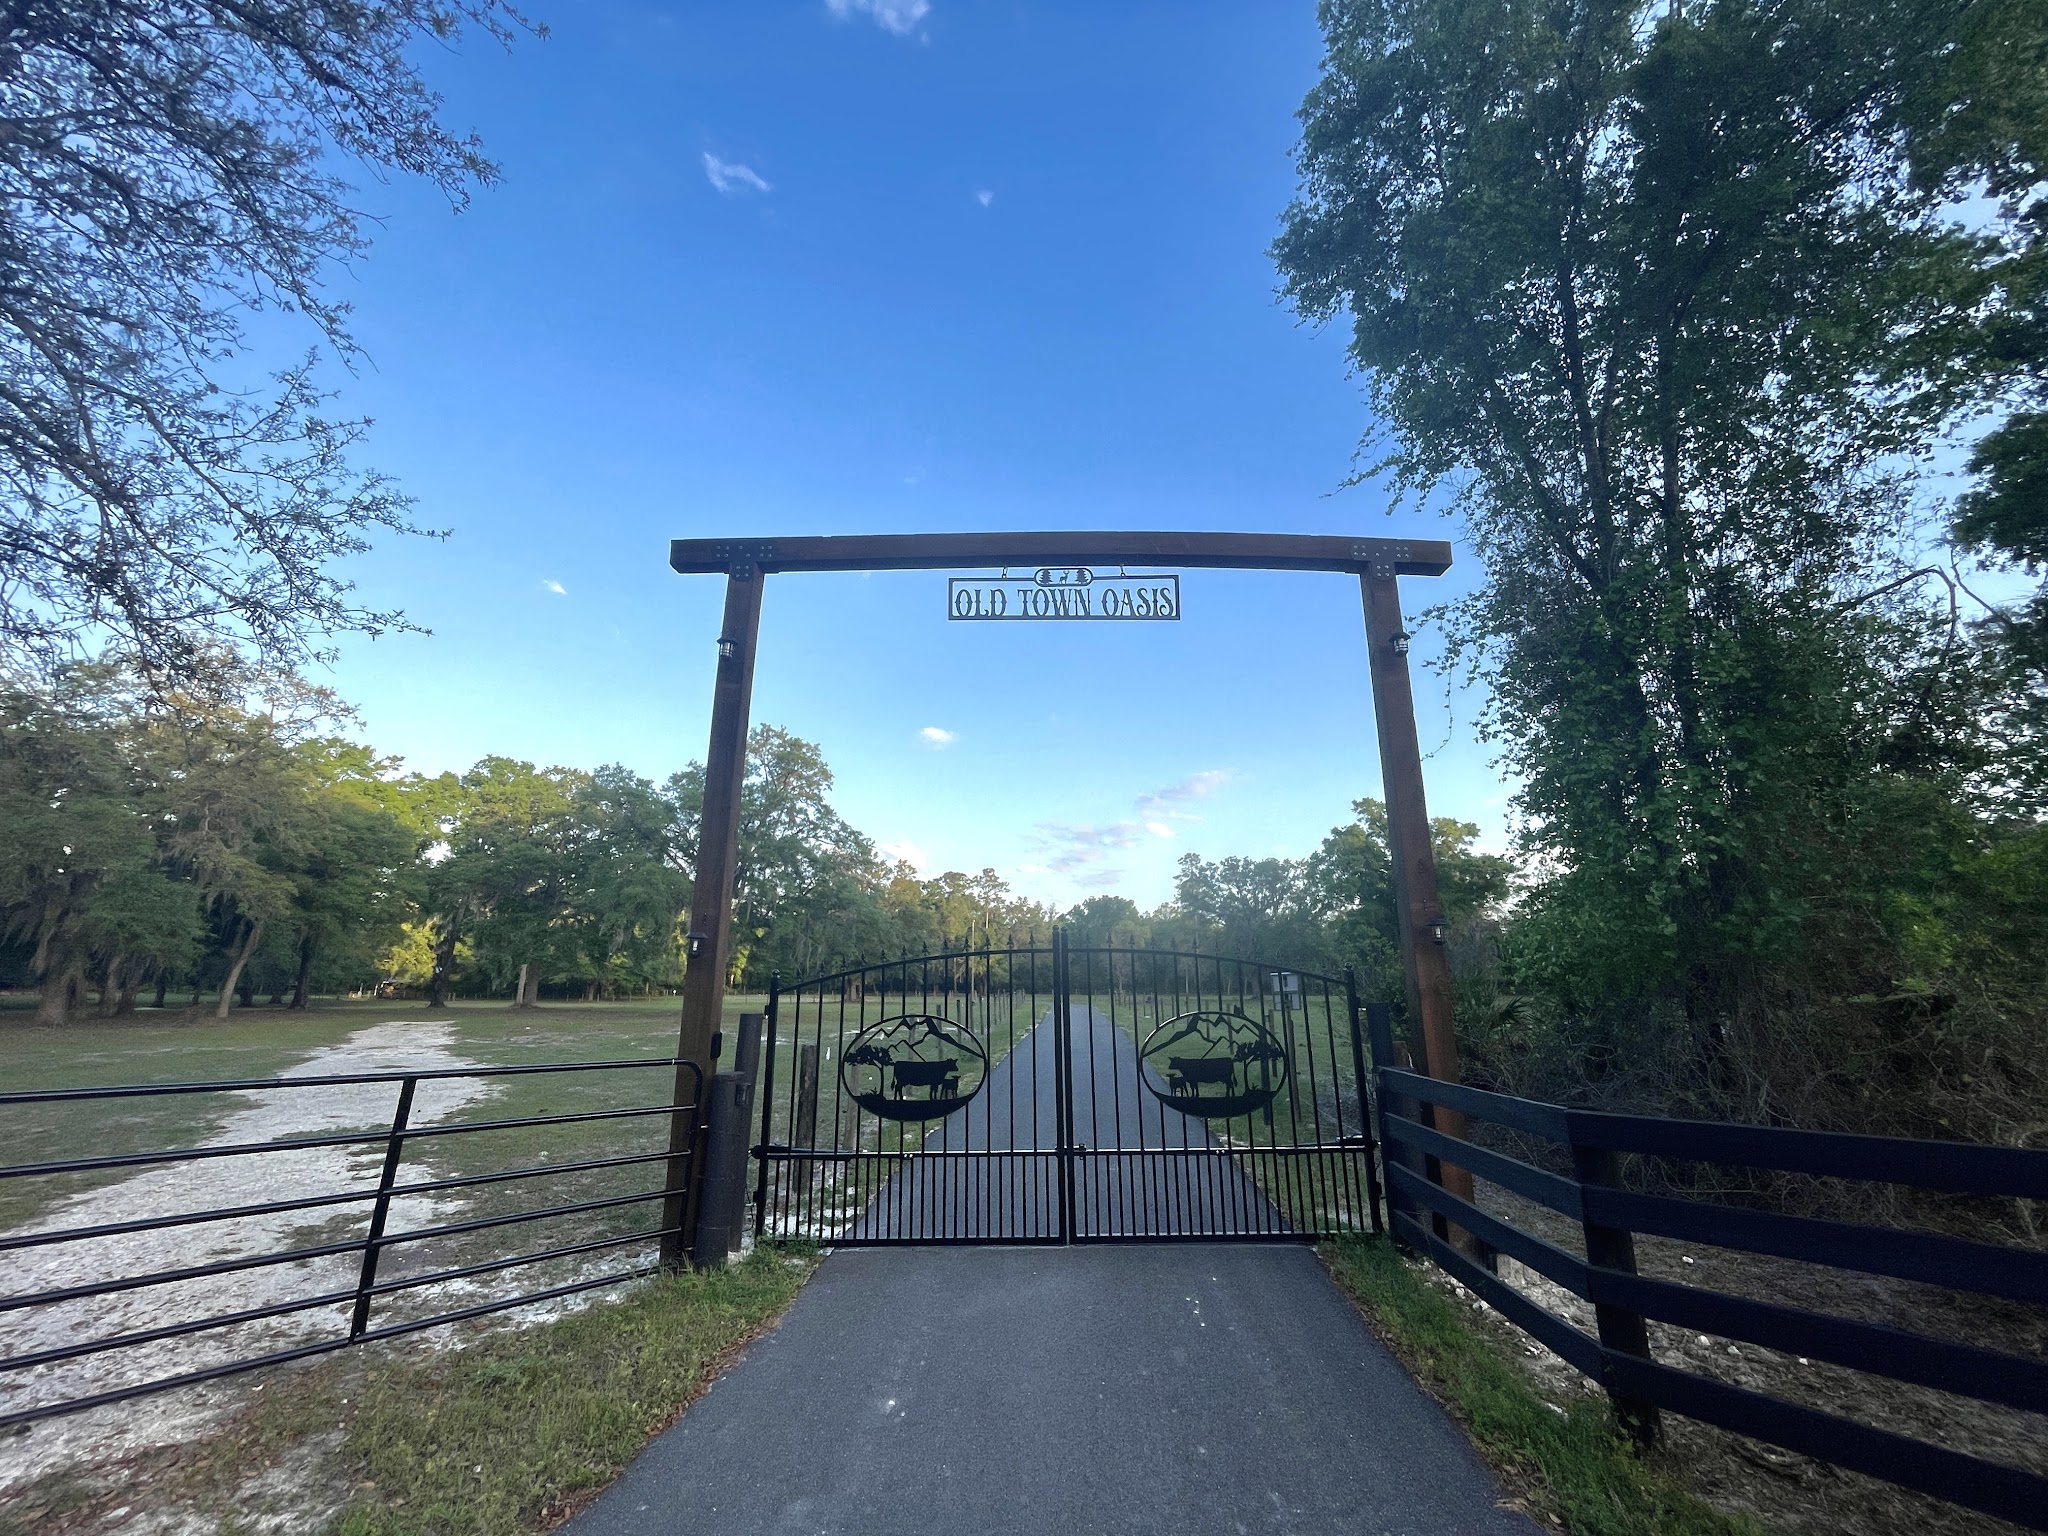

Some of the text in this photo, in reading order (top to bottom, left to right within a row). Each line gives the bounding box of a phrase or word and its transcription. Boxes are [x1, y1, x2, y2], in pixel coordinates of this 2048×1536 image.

[955, 587, 1174, 617] OLD TOWN OASIS
